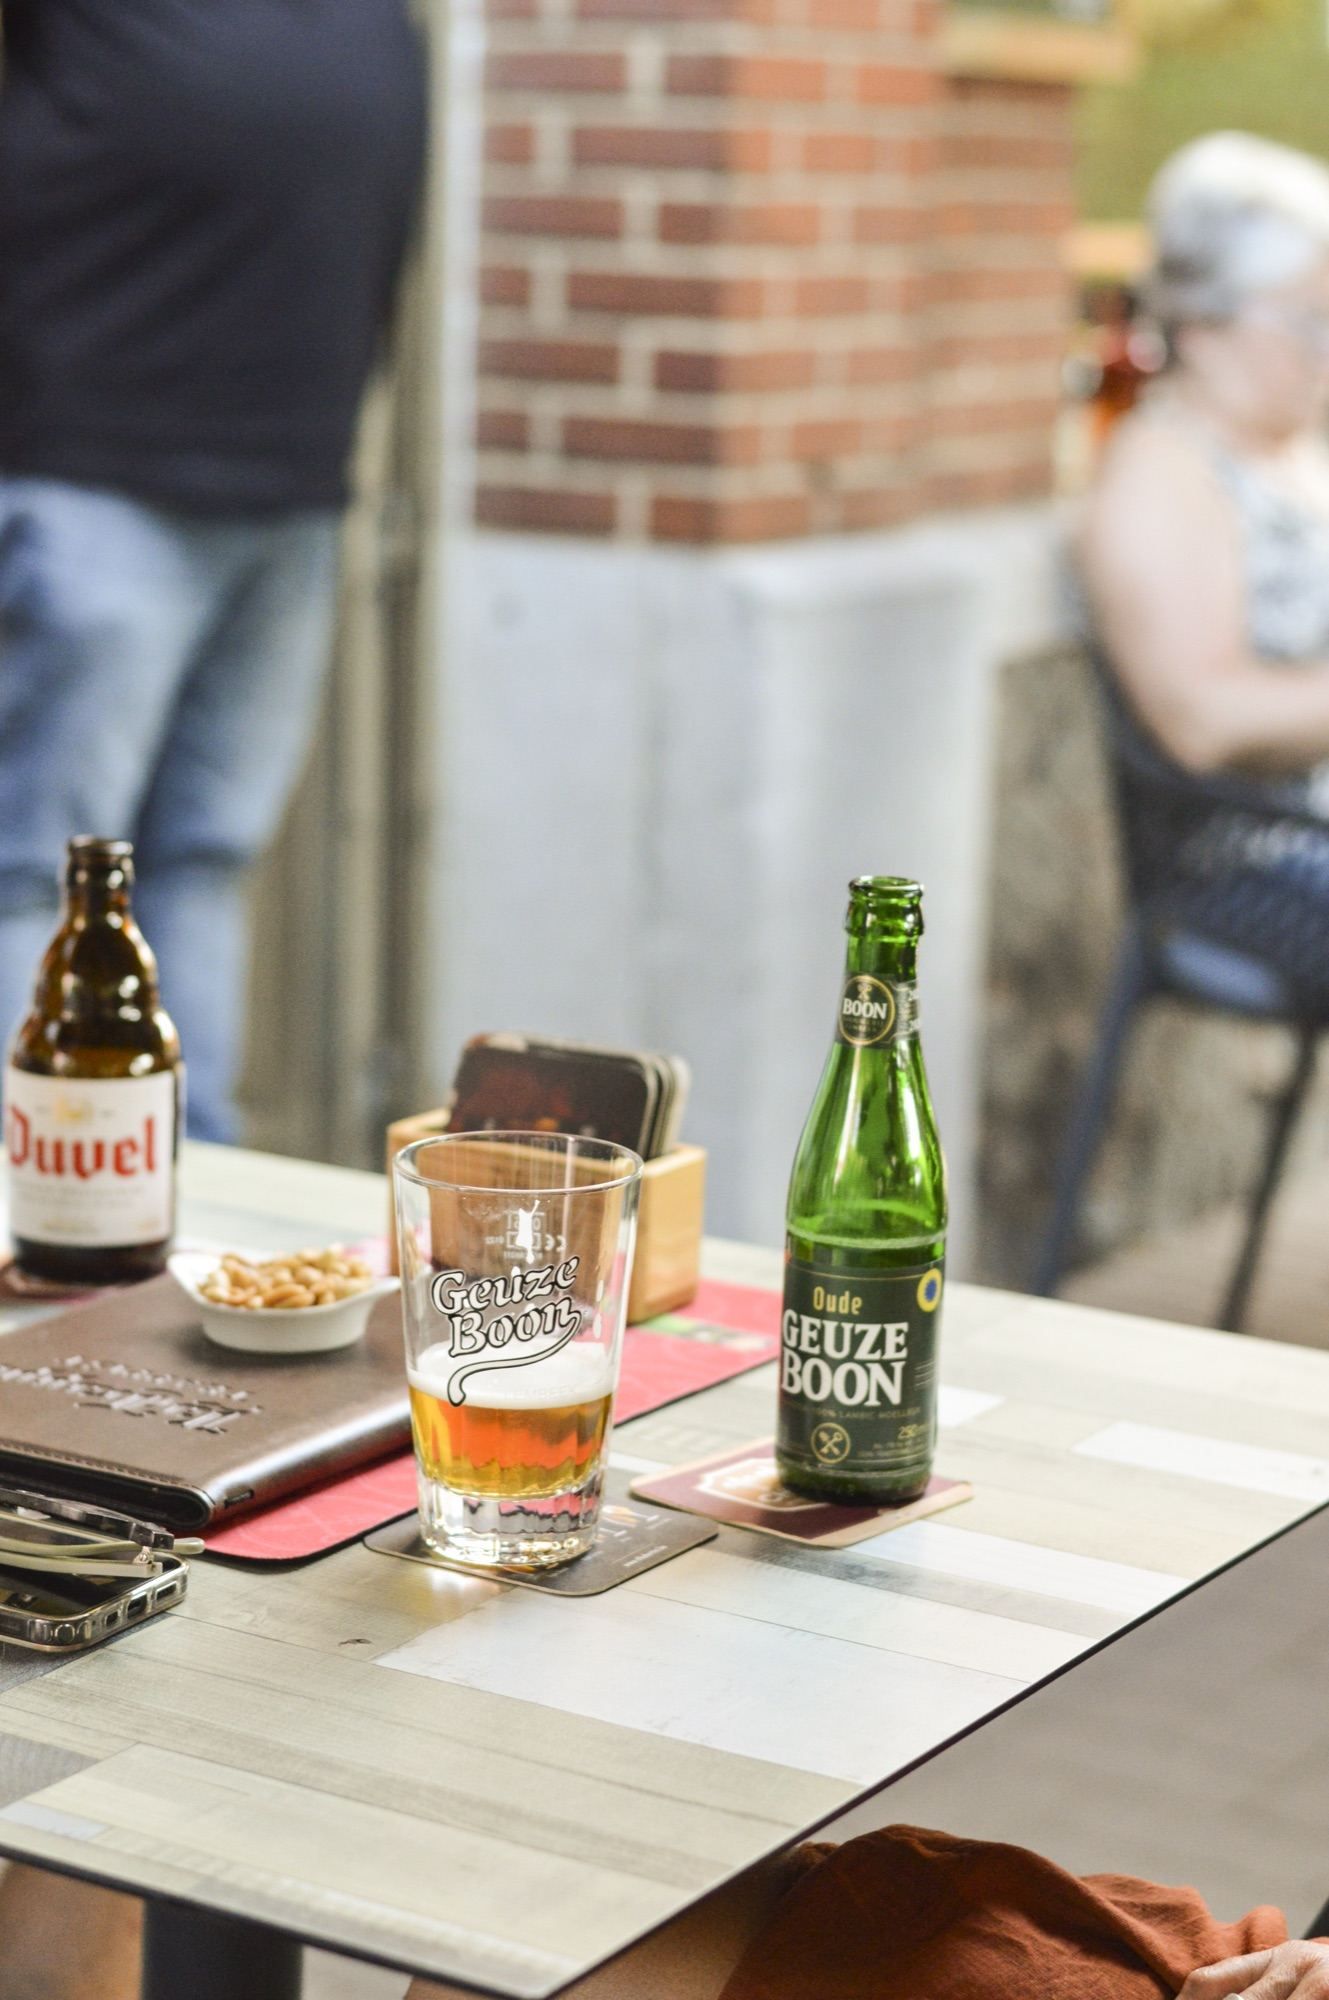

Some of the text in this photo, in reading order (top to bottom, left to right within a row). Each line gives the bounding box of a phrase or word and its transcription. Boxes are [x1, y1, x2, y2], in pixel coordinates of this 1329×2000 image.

[842, 997, 888, 1020] BOON
[431, 1255, 580, 1316] Geuze
[813, 1286, 863, 1316] Oude
[782, 1308, 909, 1361] GEUZE
[781, 1351, 907, 1407] BOON
